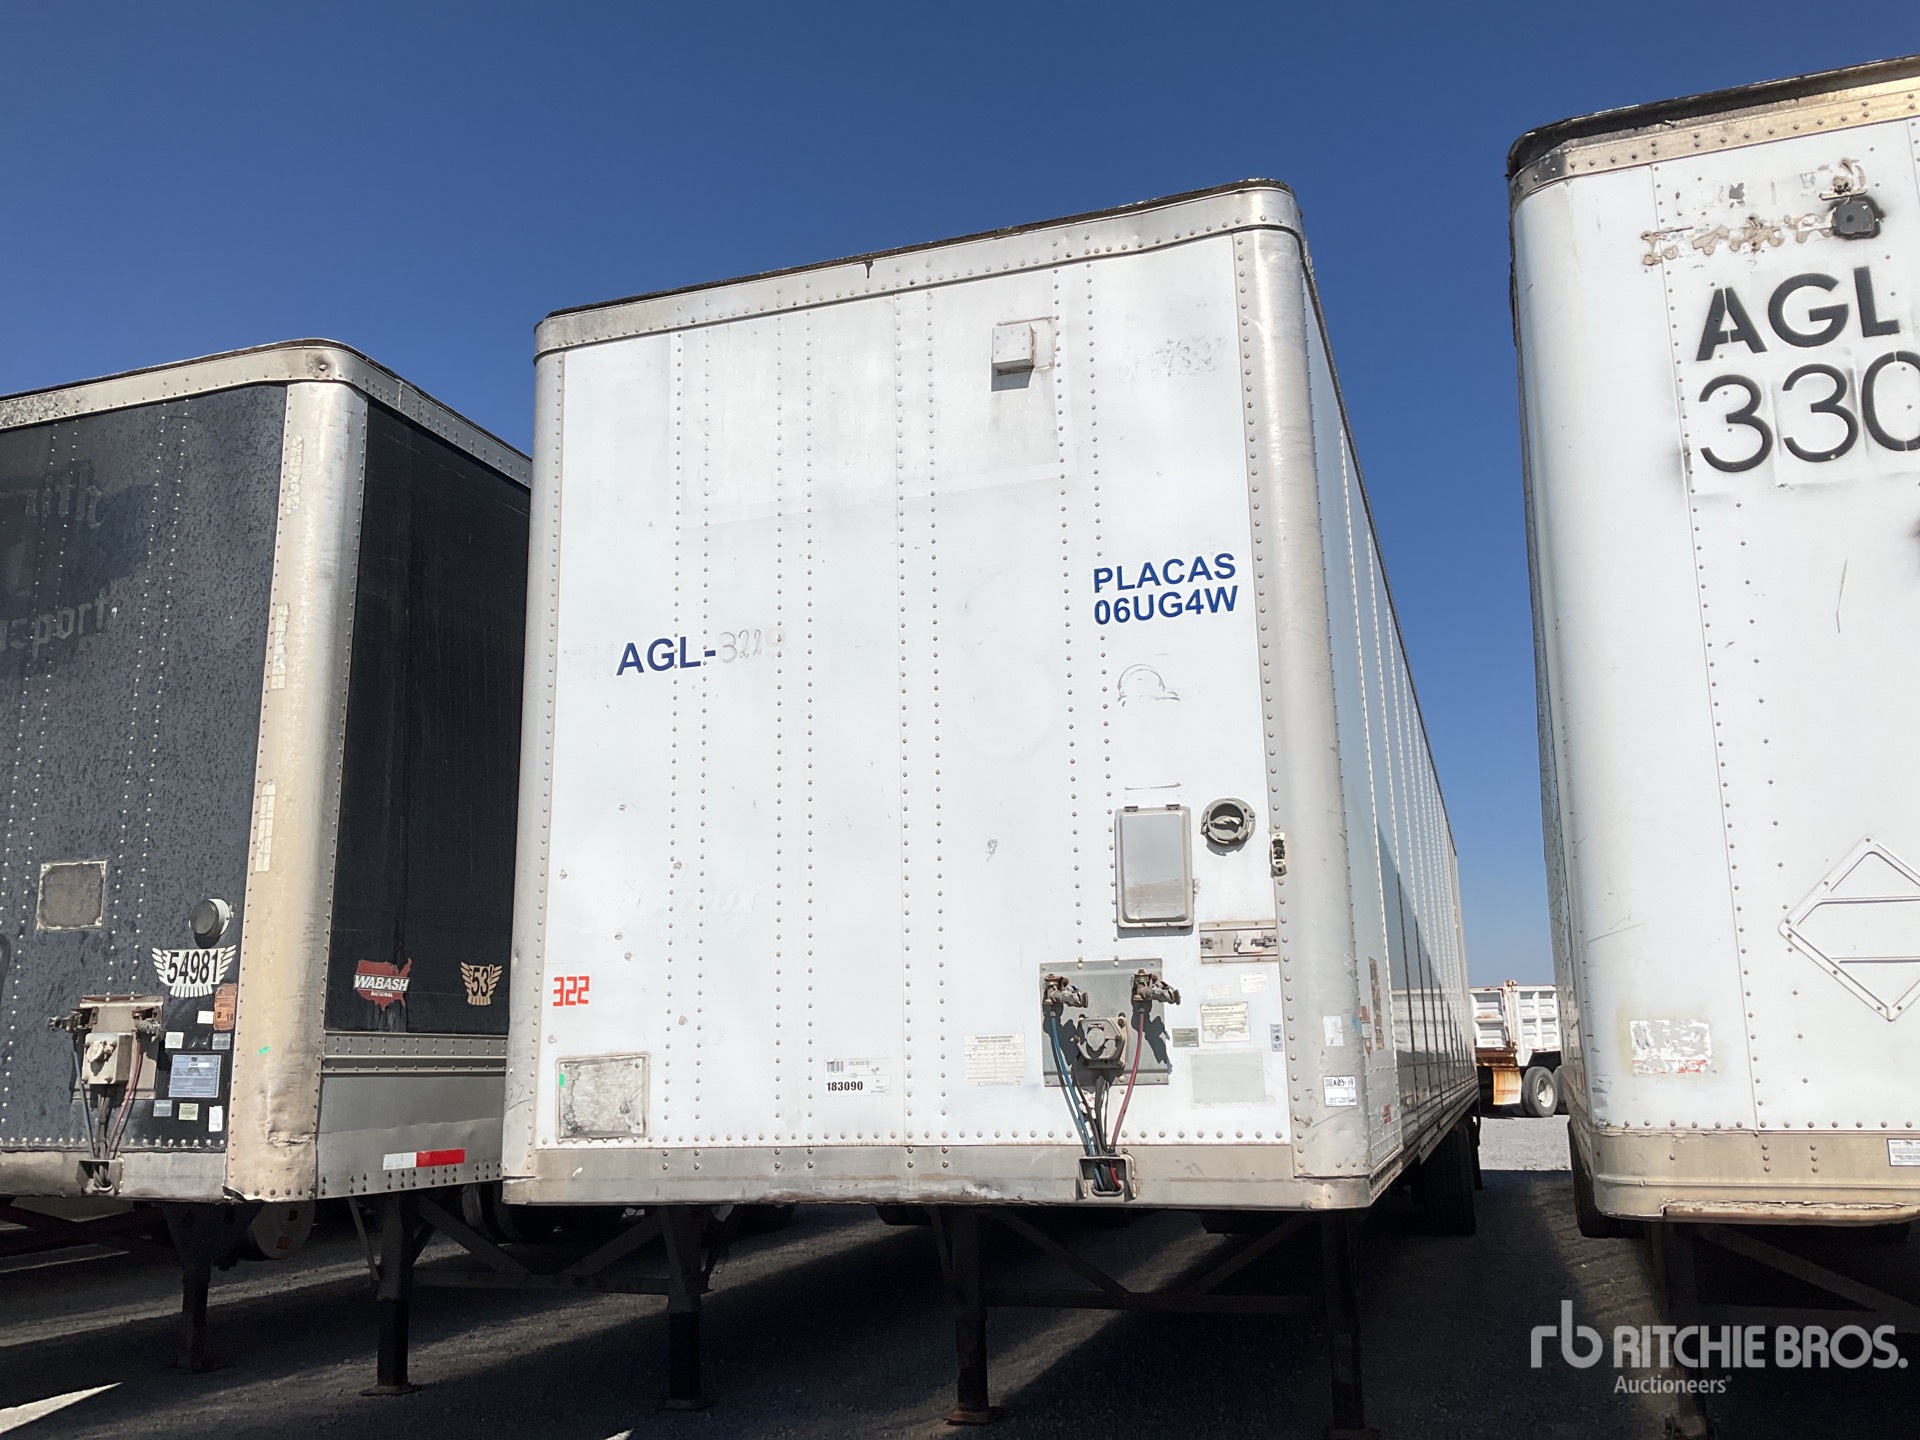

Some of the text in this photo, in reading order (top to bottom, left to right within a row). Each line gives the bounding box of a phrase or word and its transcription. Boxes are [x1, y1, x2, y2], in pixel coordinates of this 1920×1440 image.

[1696, 265, 1901, 362] AGL
[1699, 350, 1920, 473] 330
[1093, 552, 1237, 594] PLACAS
[1094, 585, 1239, 625] 06UG4W
[166, 949, 220, 985] 54981
[353, 974, 410, 992] WABASH
[370, 990, 394, 998] NATIONAL
[552, 975, 590, 1007] 322
[826, 1080, 864, 1092] 183090
